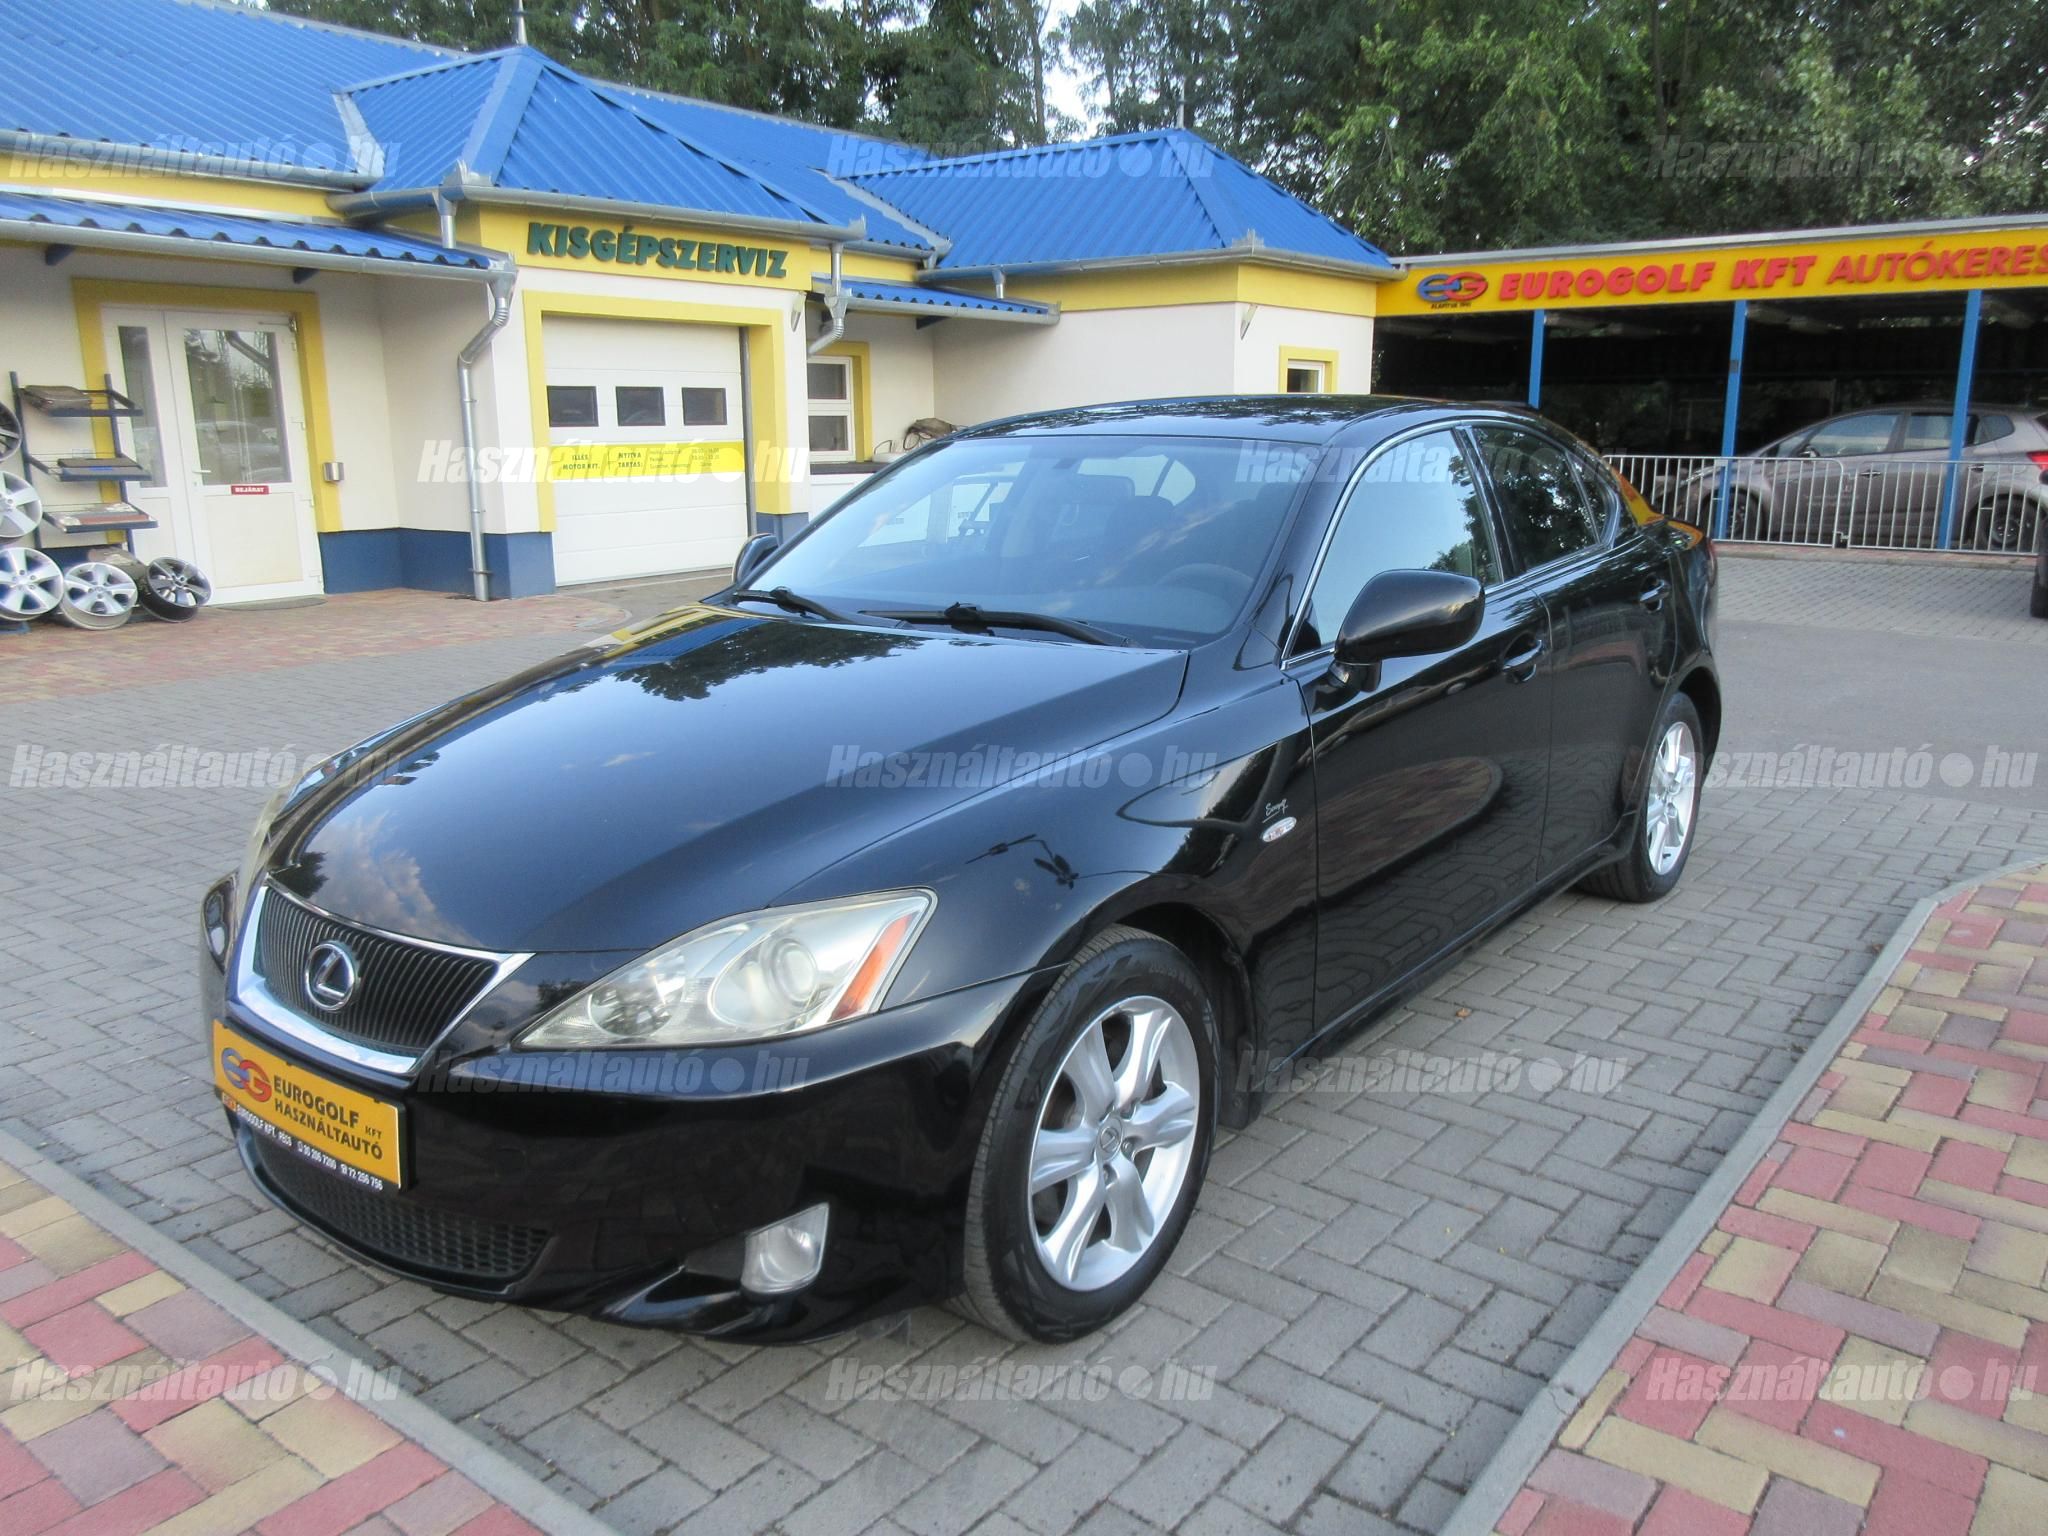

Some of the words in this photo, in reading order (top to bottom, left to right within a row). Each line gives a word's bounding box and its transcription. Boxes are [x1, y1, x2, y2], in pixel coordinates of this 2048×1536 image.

[527, 222, 788, 278] KISGÉPSZERVIZ
[1499, 261, 1716, 300] EUROGOLF
[1730, 256, 1817, 290] KFT
[274, 1075, 360, 1128] EUROGOLF
[365, 1125, 382, 1140] KFT
[275, 1098, 383, 1160] HASZNÁLTAUTÓ
